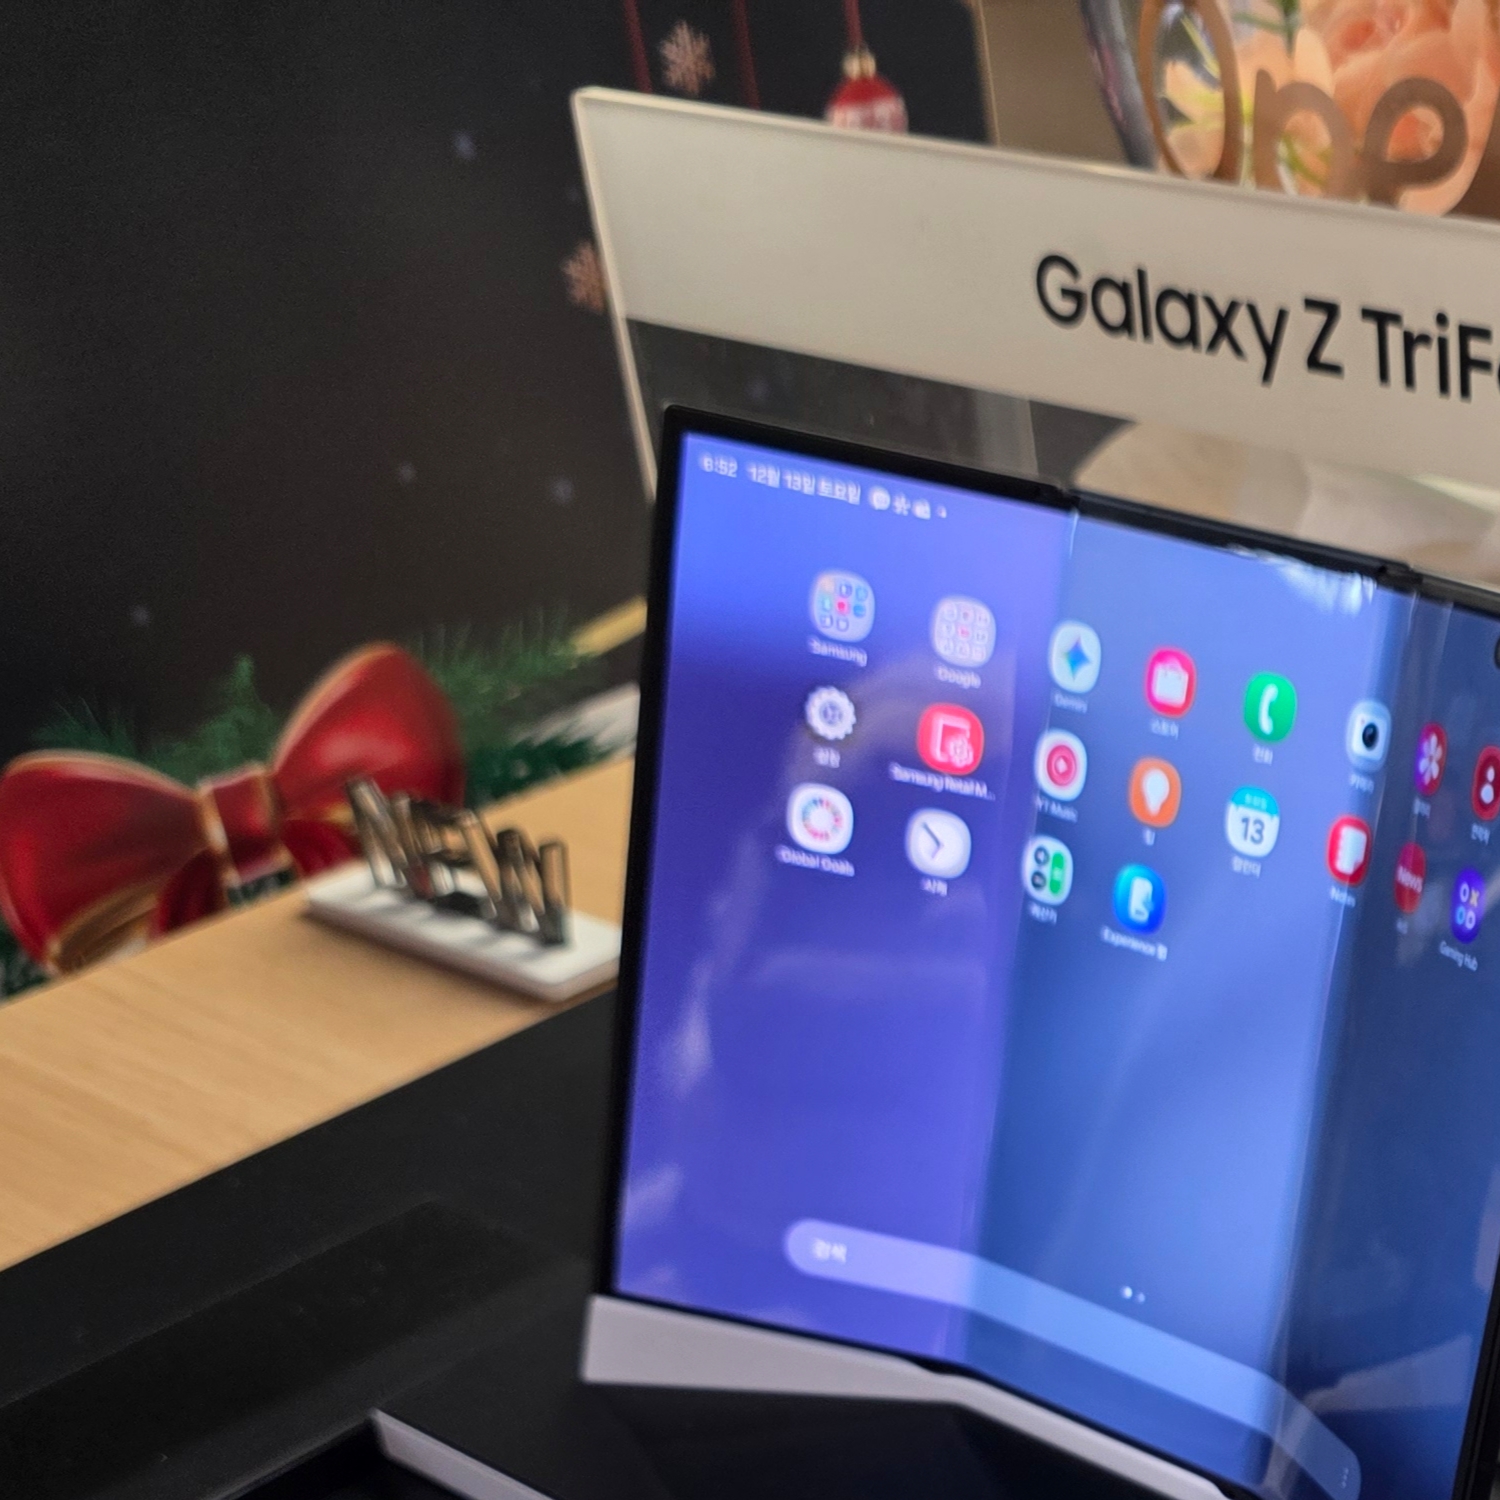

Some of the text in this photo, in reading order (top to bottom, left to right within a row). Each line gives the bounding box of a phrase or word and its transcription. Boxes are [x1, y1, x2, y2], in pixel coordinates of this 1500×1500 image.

[1035, 253, 1290, 386] Galaxy
[1303, 297, 1345, 379] Z
[1241, 816, 1266, 845] 13
